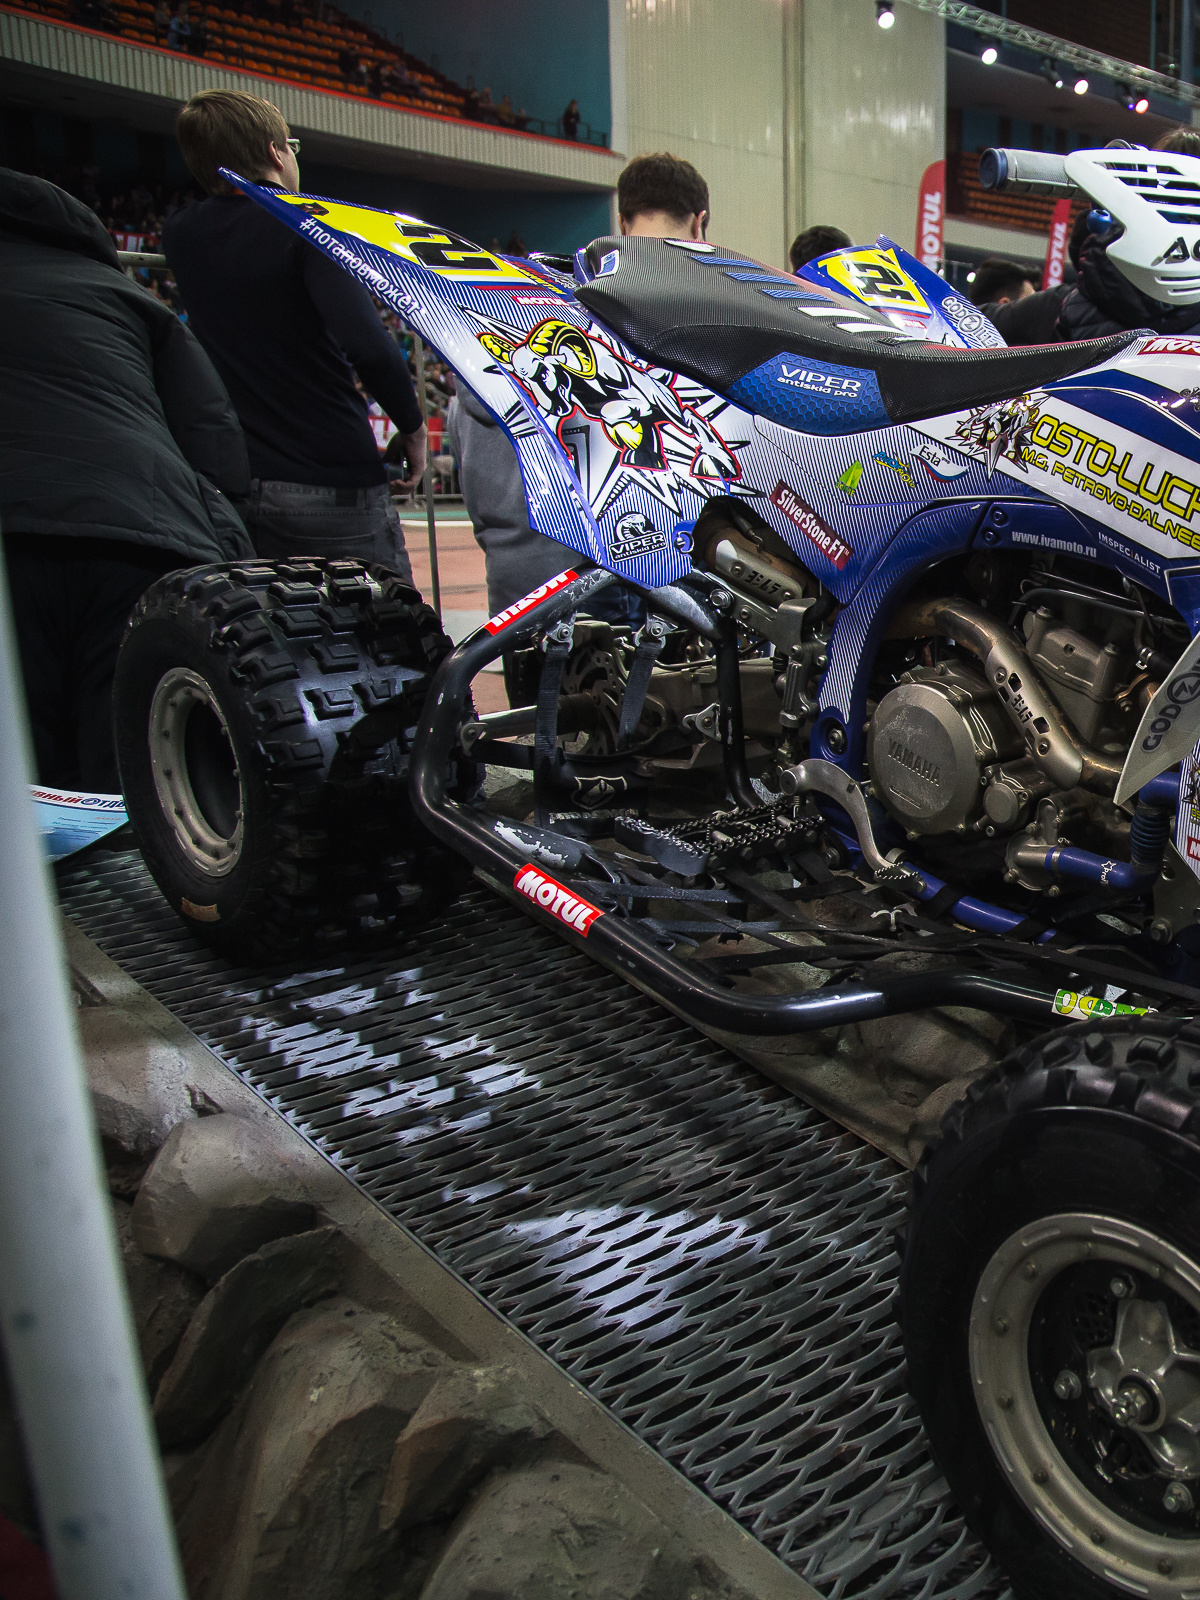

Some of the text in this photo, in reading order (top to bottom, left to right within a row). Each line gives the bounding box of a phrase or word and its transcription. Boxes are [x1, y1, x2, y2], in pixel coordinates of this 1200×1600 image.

[394, 222, 502, 271] 2
[777, 376, 859, 399] antiskid pro
[780, 364, 862, 393] VIPER
[918, 444, 942, 467] Esta
[776, 487, 833, 549] SilverStone
[610, 533, 665, 554] VIPER
[614, 539, 667, 560] antiskid pro
[1011, 530, 1098, 558] www.ivamoto.ru
[887, 737, 941, 788] YAMAHA
[516, 871, 592, 932] MOTUL
